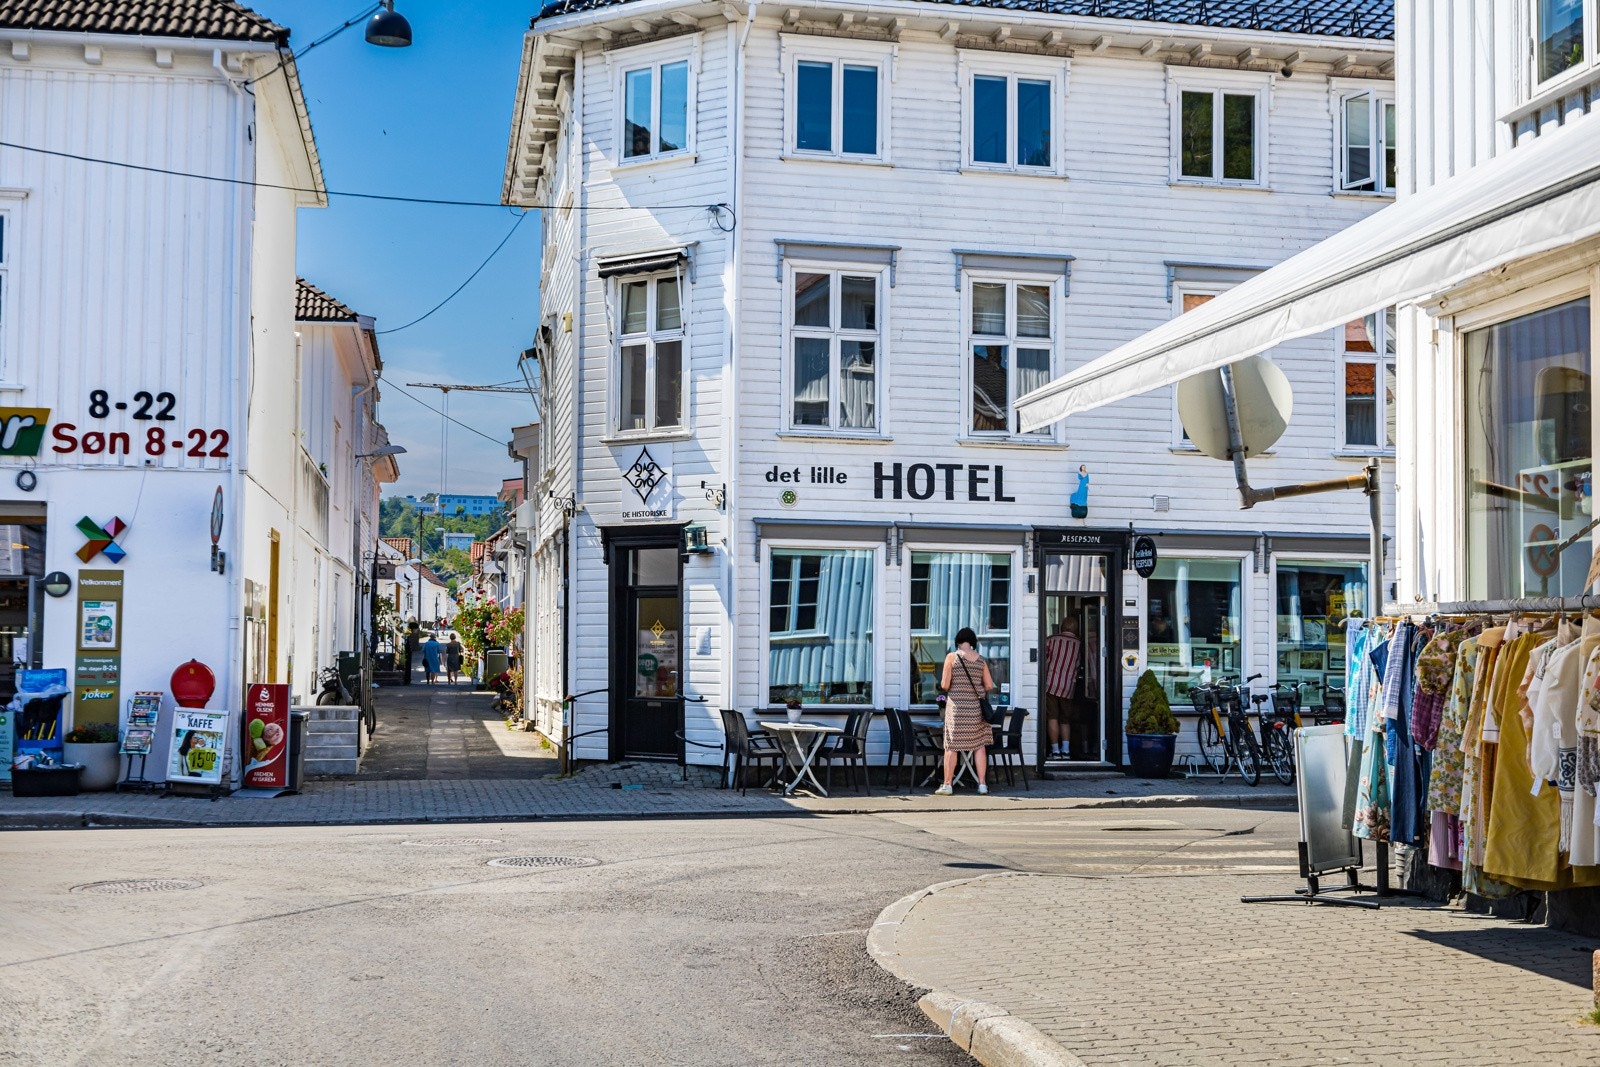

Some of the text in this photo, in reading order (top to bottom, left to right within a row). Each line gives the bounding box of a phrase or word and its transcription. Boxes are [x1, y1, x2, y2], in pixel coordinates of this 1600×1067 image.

[88, 389, 176, 421] 8-22
[0, 416, 35, 449] r
[52, 423, 229, 458] Søn 8-22
[765, 465, 848, 484] det lille
[873, 462, 1016, 502] HOTEL
[631, 510, 667, 518] HISTORISKE
[1061, 534, 1101, 544] RESEPSJON
[81, 688, 112, 701] joker
[188, 718, 213, 729] KAFFE
